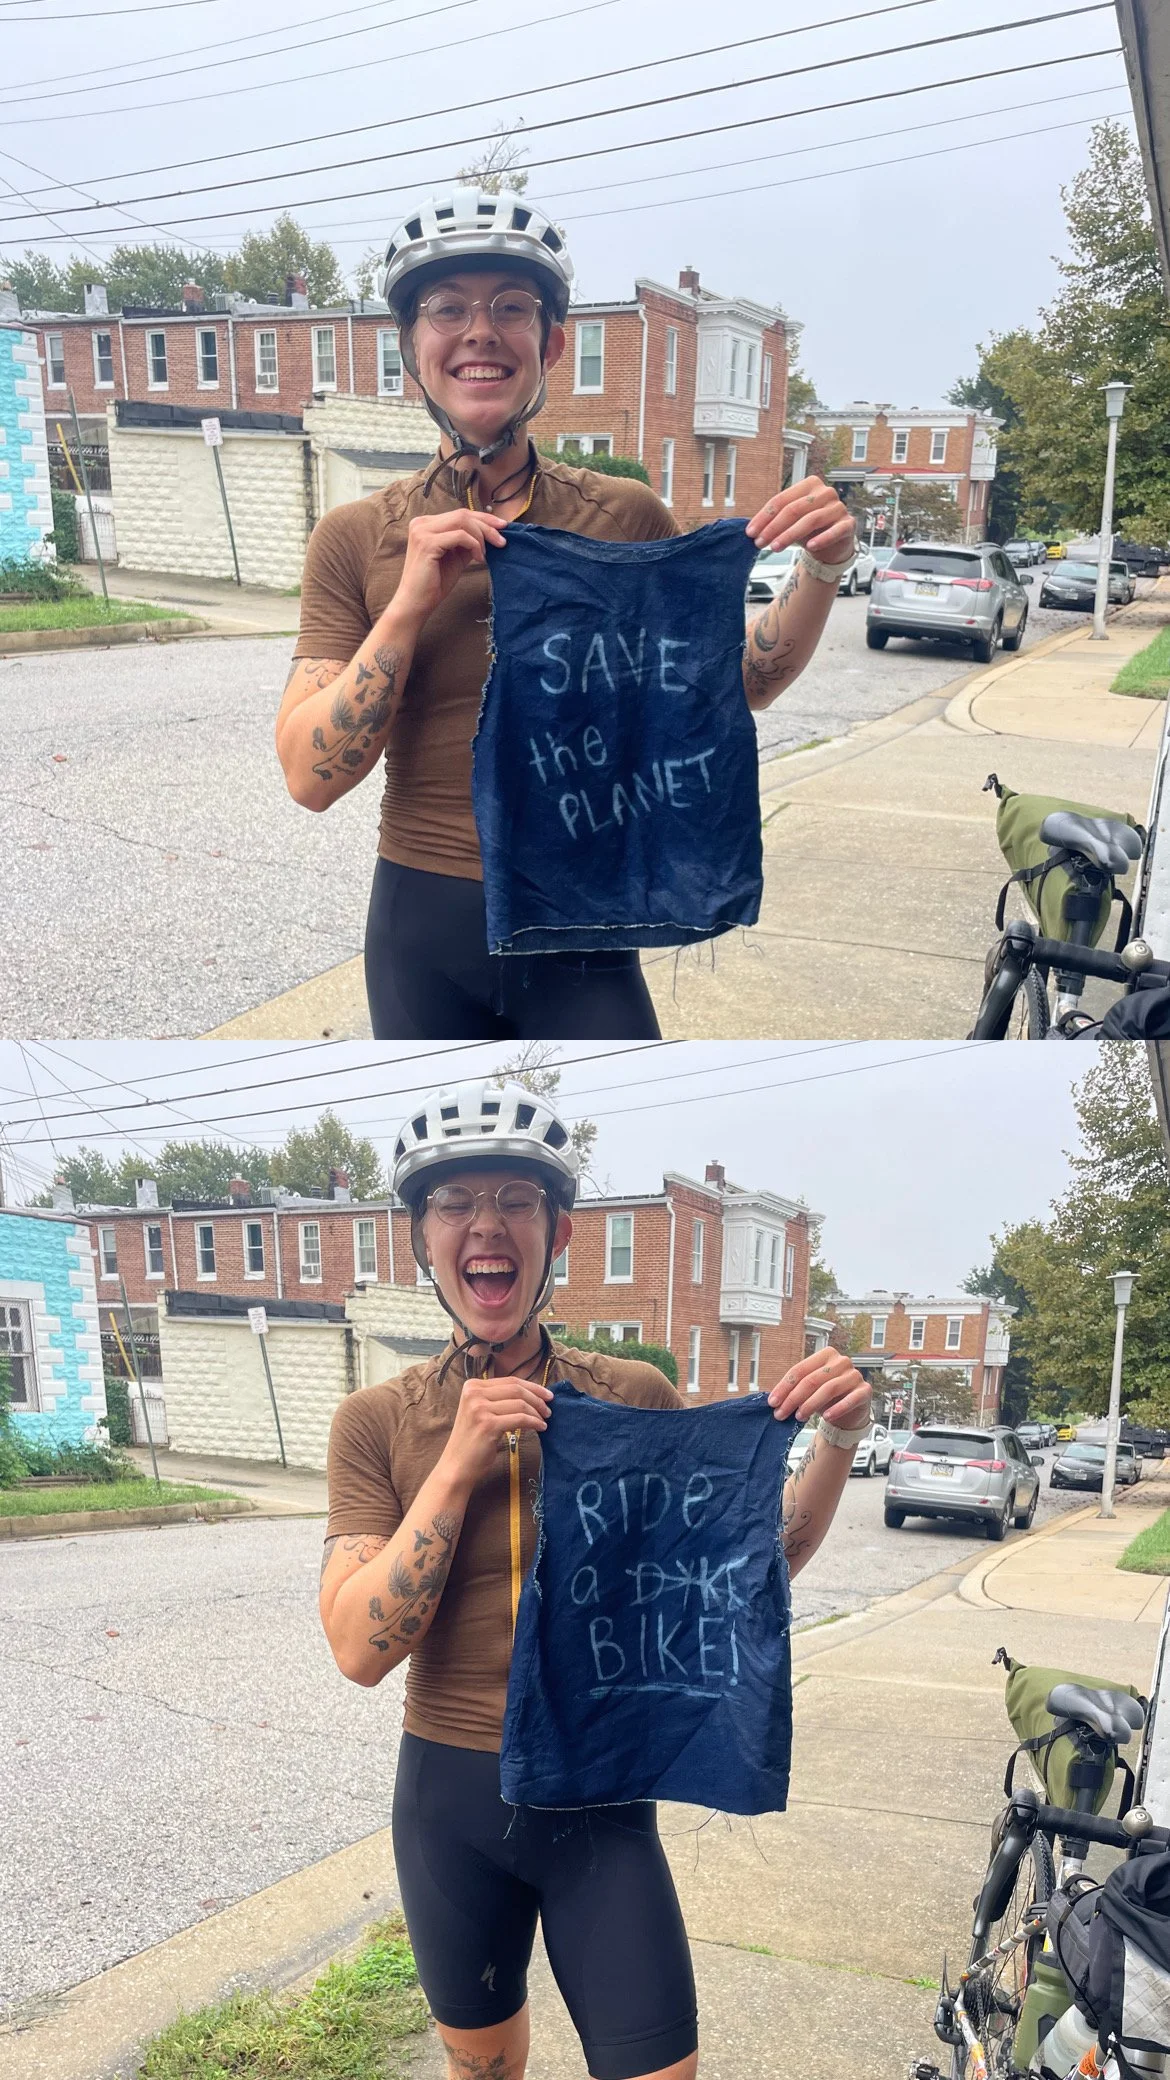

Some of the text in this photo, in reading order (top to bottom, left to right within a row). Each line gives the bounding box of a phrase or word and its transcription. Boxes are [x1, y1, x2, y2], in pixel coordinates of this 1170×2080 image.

[540, 628, 690, 694] SAVE
[529, 725, 607, 784] the
[559, 747, 716, 840] PLANET
[570, 1565, 600, 1604] a
[589, 1612, 739, 1687] BIKE!
